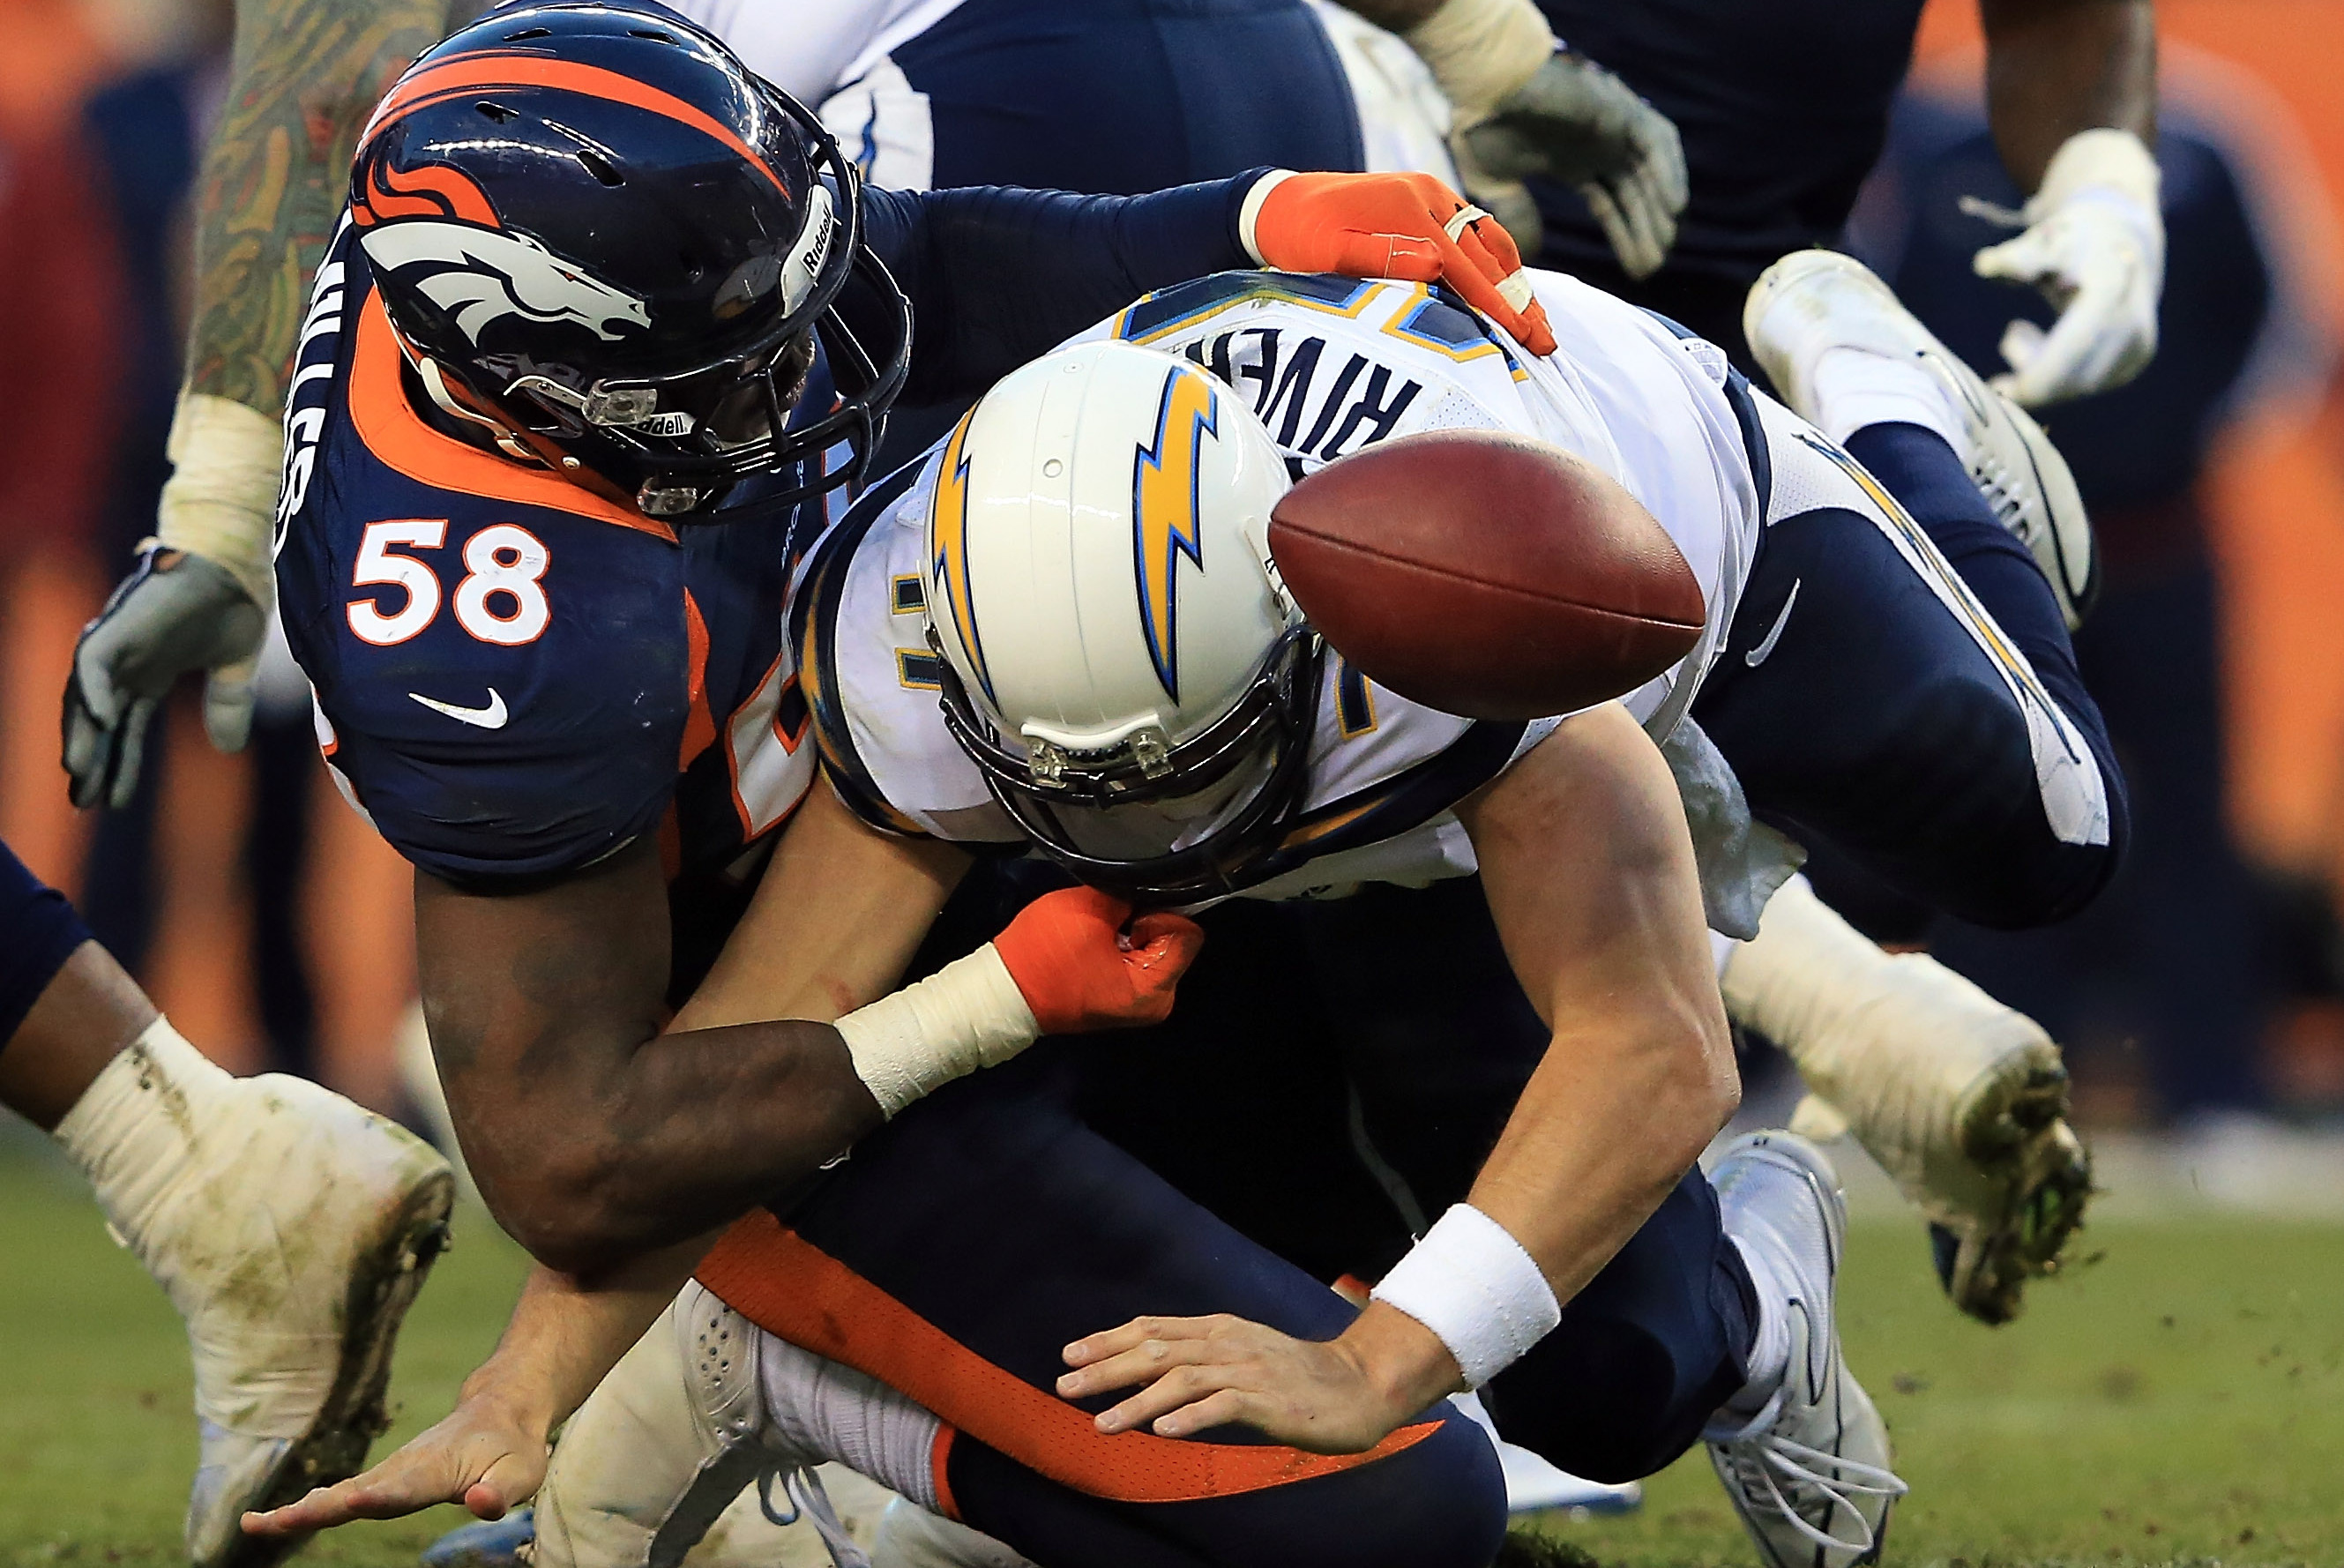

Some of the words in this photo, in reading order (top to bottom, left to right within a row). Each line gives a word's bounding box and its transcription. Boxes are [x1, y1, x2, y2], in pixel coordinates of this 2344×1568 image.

[802, 199, 832, 273] Riddell
[630, 414, 684, 435] ddell
[347, 519, 552, 646] 58
